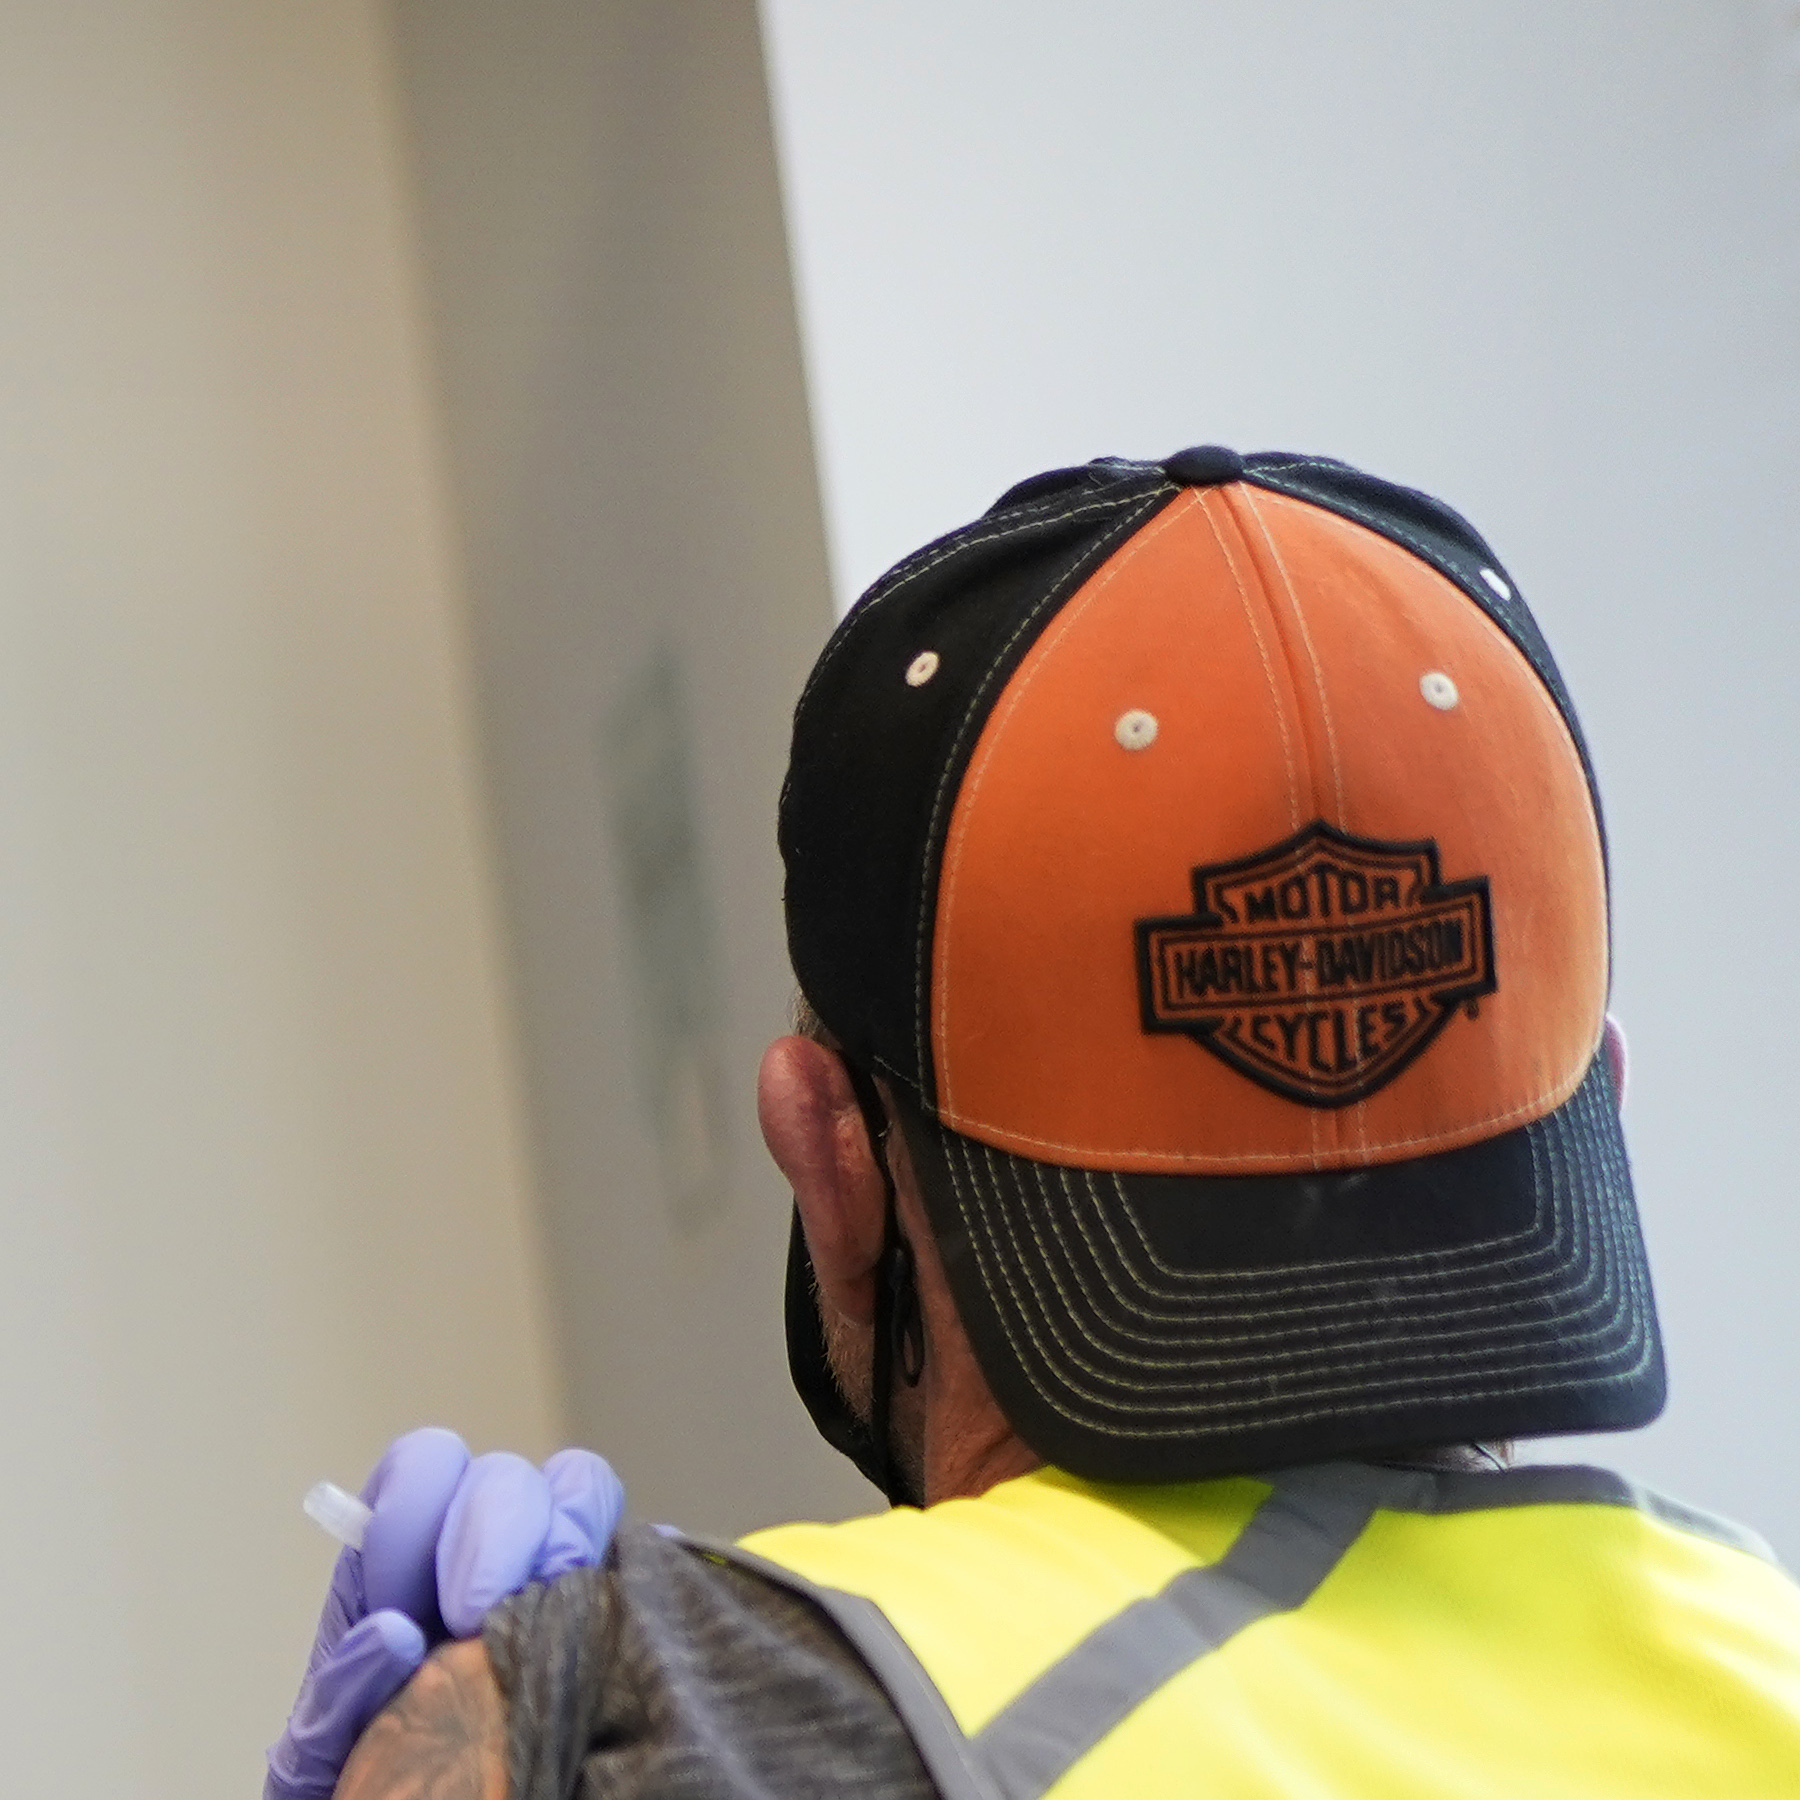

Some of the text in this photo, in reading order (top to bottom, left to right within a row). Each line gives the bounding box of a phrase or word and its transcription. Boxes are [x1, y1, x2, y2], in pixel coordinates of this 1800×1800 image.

[1244, 862, 1403, 923] MOTOR
[1173, 918, 1463, 1000] HARLEY-DAVIDSON
[1251, 999, 1408, 1073] CYCLES
